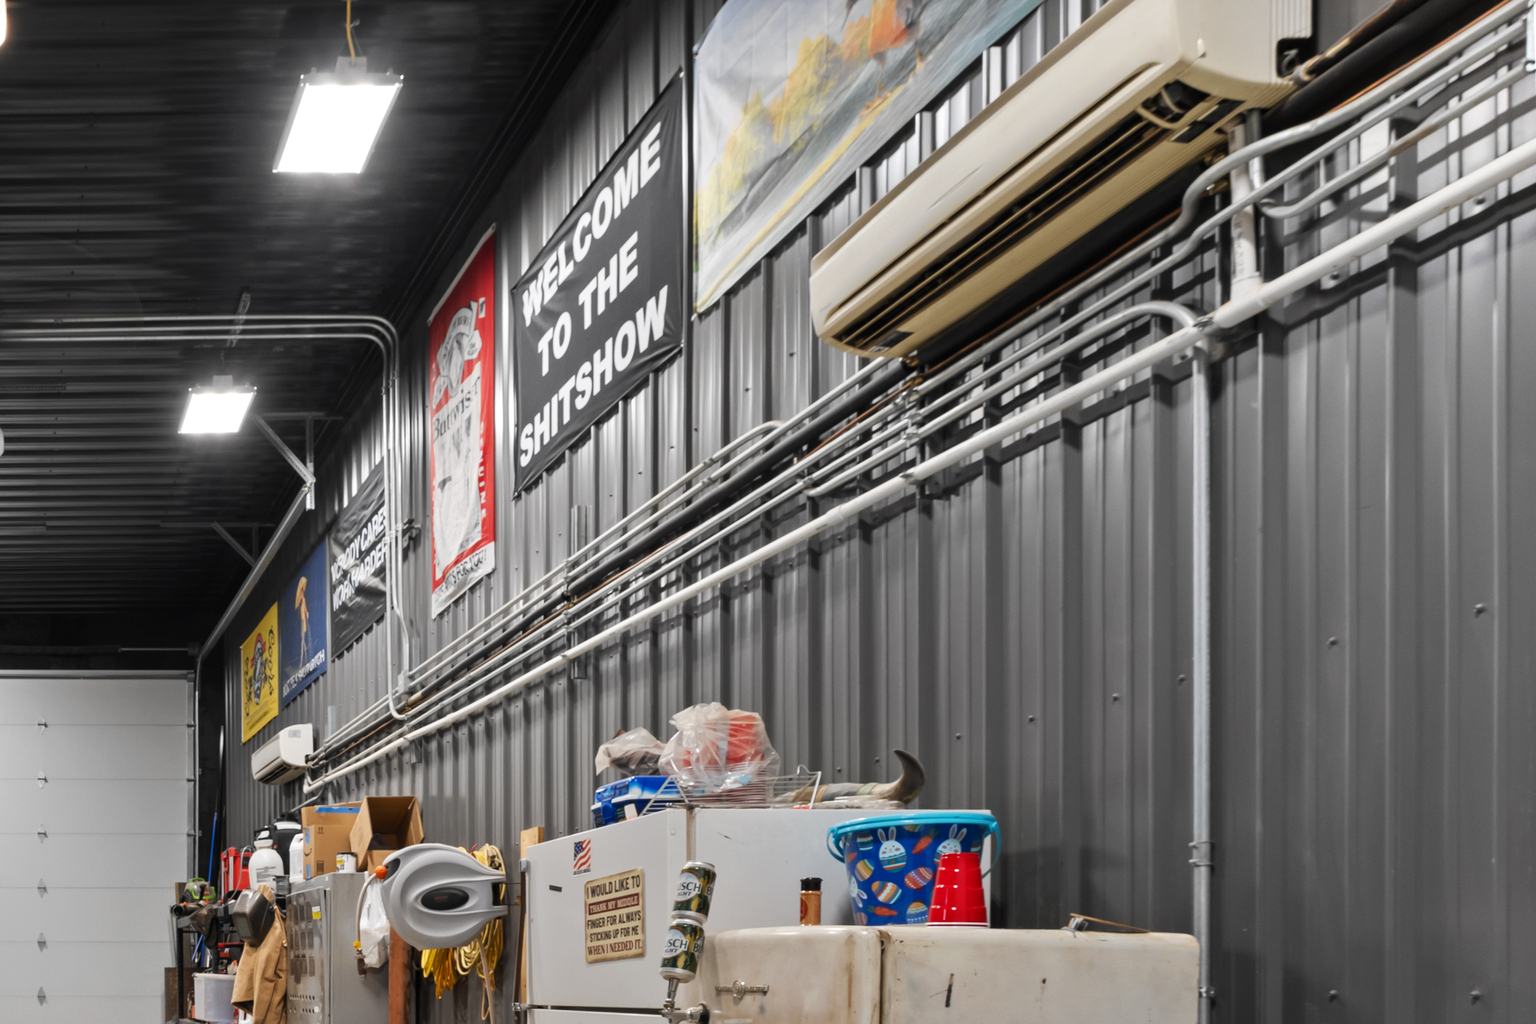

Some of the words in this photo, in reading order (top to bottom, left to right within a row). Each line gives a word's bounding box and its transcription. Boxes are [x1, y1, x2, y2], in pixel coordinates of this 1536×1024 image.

[522, 121, 661, 327] WELCOME
[537, 311, 572, 377] TO
[578, 230, 639, 330] THE
[519, 284, 668, 468] SHITSHOW
[590, 881, 614, 898] WOULD
[614, 878, 630, 893] LIKE
[631, 874, 641, 889] TO
[589, 901, 607, 914] THANK
[607, 900, 617, 910] MY
[617, 896, 639, 908] MIDDLE
[587, 918, 606, 930] FINGER
[606, 915, 617, 926] FOR
[618, 910, 642, 925] ALWAYS
[589, 930, 612, 943] STICKING
[612, 929, 620, 939] UP
[620, 927, 631, 938] FOR
[631, 925, 639, 936] ME
[587, 945, 605, 956] WHEN
[609, 940, 634, 953] NEEDED
